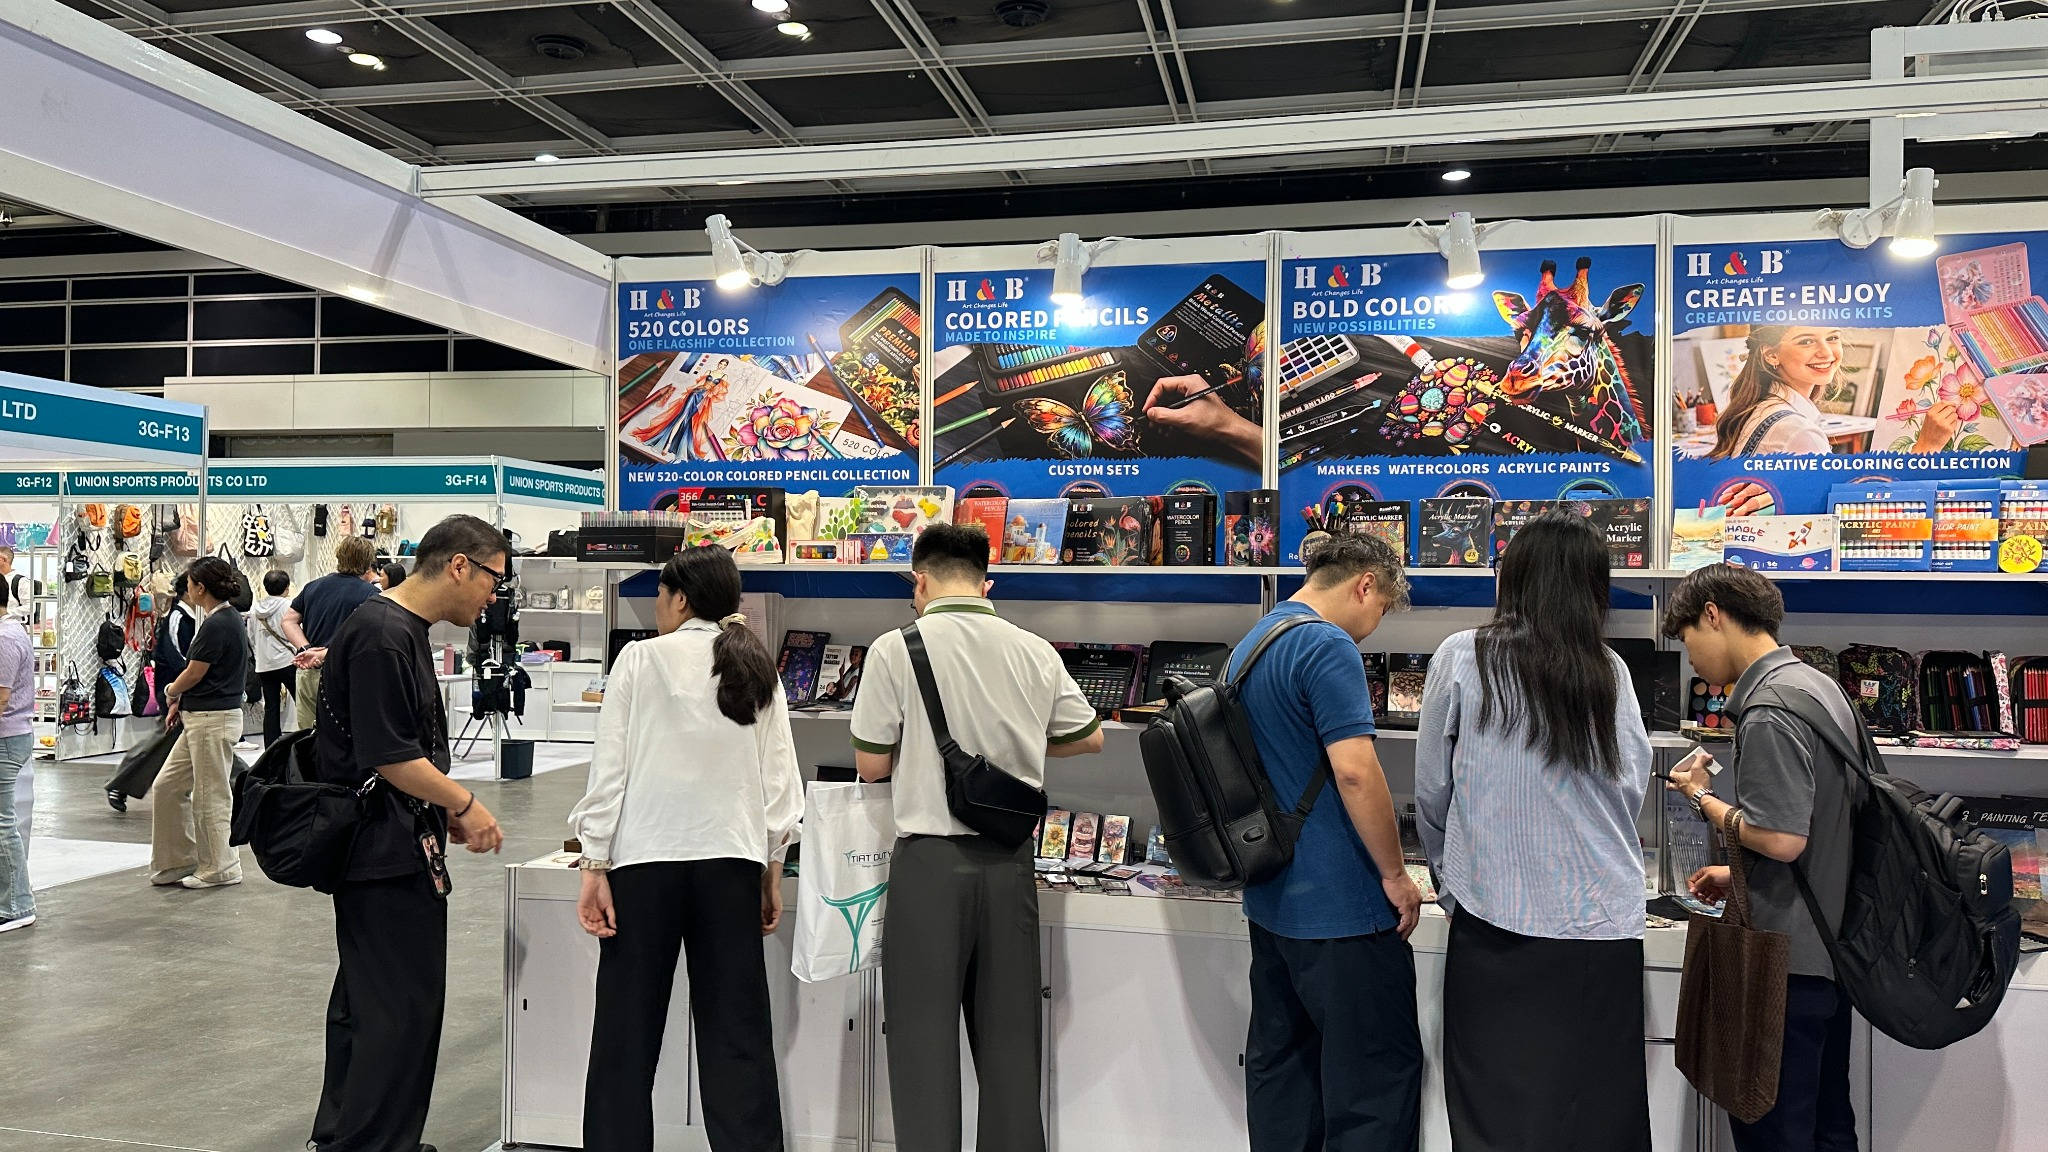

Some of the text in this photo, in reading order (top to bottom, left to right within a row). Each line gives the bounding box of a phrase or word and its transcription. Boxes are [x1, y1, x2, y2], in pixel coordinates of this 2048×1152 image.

[1687, 253, 1711, 277] H
[1760, 250, 1784, 274] B
[1294, 266, 1316, 289] H
[1360, 263, 1381, 286] B
[1720, 277, 1749, 285] Changes
[947, 280, 967, 301] H
[1005, 277, 1024, 300] B
[1685, 282, 1891, 309] CREATE ENJOY
[629, 290, 648, 310] H
[683, 288, 700, 309] B
[973, 302, 997, 310] Changes
[1193, 292, 1244, 328] Metallic
[1293, 296, 1468, 319] BOLD COLOR
[945, 306, 1149, 330] COLORED PCILS
[1685, 306, 1893, 325] CREATIVE COLORING KITS
[628, 318, 750, 338] 520 COLORS
[1293, 318, 1436, 334] NEW POSSIBILITIES
[946, 328, 1057, 342] MADE TO INSPIRE
[628, 335, 795, 350] ONE FLAGSHIP COLLECTION
[879, 326, 919, 360] PREMIUM
[2, 400, 37, 421] LTD
[138, 420, 190, 442] 3G-F13
[1564, 422, 1599, 443] MARKER
[842, 438, 860, 450] 520
[1048, 464, 1139, 476] CUSTOM SETS
[1317, 462, 1611, 475] MARKERS WATERCOLORS ACRYLIC PAINTS
[1744, 456, 2011, 471] CREATIVE COLORING COLLECTION
[16, 476, 52, 488] 3G-F12
[75, 475, 268, 487] UNION SPORTS PRODUTS CO LTD
[445, 474, 487, 486] 3G-F14
[628, 469, 910, 482] NEW 520-COLOR COLORED PENCIL COLLECTION
[510, 475, 533, 489] UNION
[535, 478, 564, 493] SPORTS
[565, 482, 600, 498] PRODUCTS
[680, 492, 698, 501] 366
[1068, 518, 1100, 528] olored
[1428, 513, 1453, 521] Acrylic
[1606, 522, 1642, 534] Acrylic
[1725, 525, 1766, 537] HABLE
[1839, 521, 1917, 529] ACRYLIC PAINT
[1606, 534, 1643, 542] Marker
[1725, 534, 1756, 543] RKER
[1629, 554, 1642, 562] 120
[1980, 812, 2028, 824] PAINTING
[2032, 811, 2048, 822] TE
